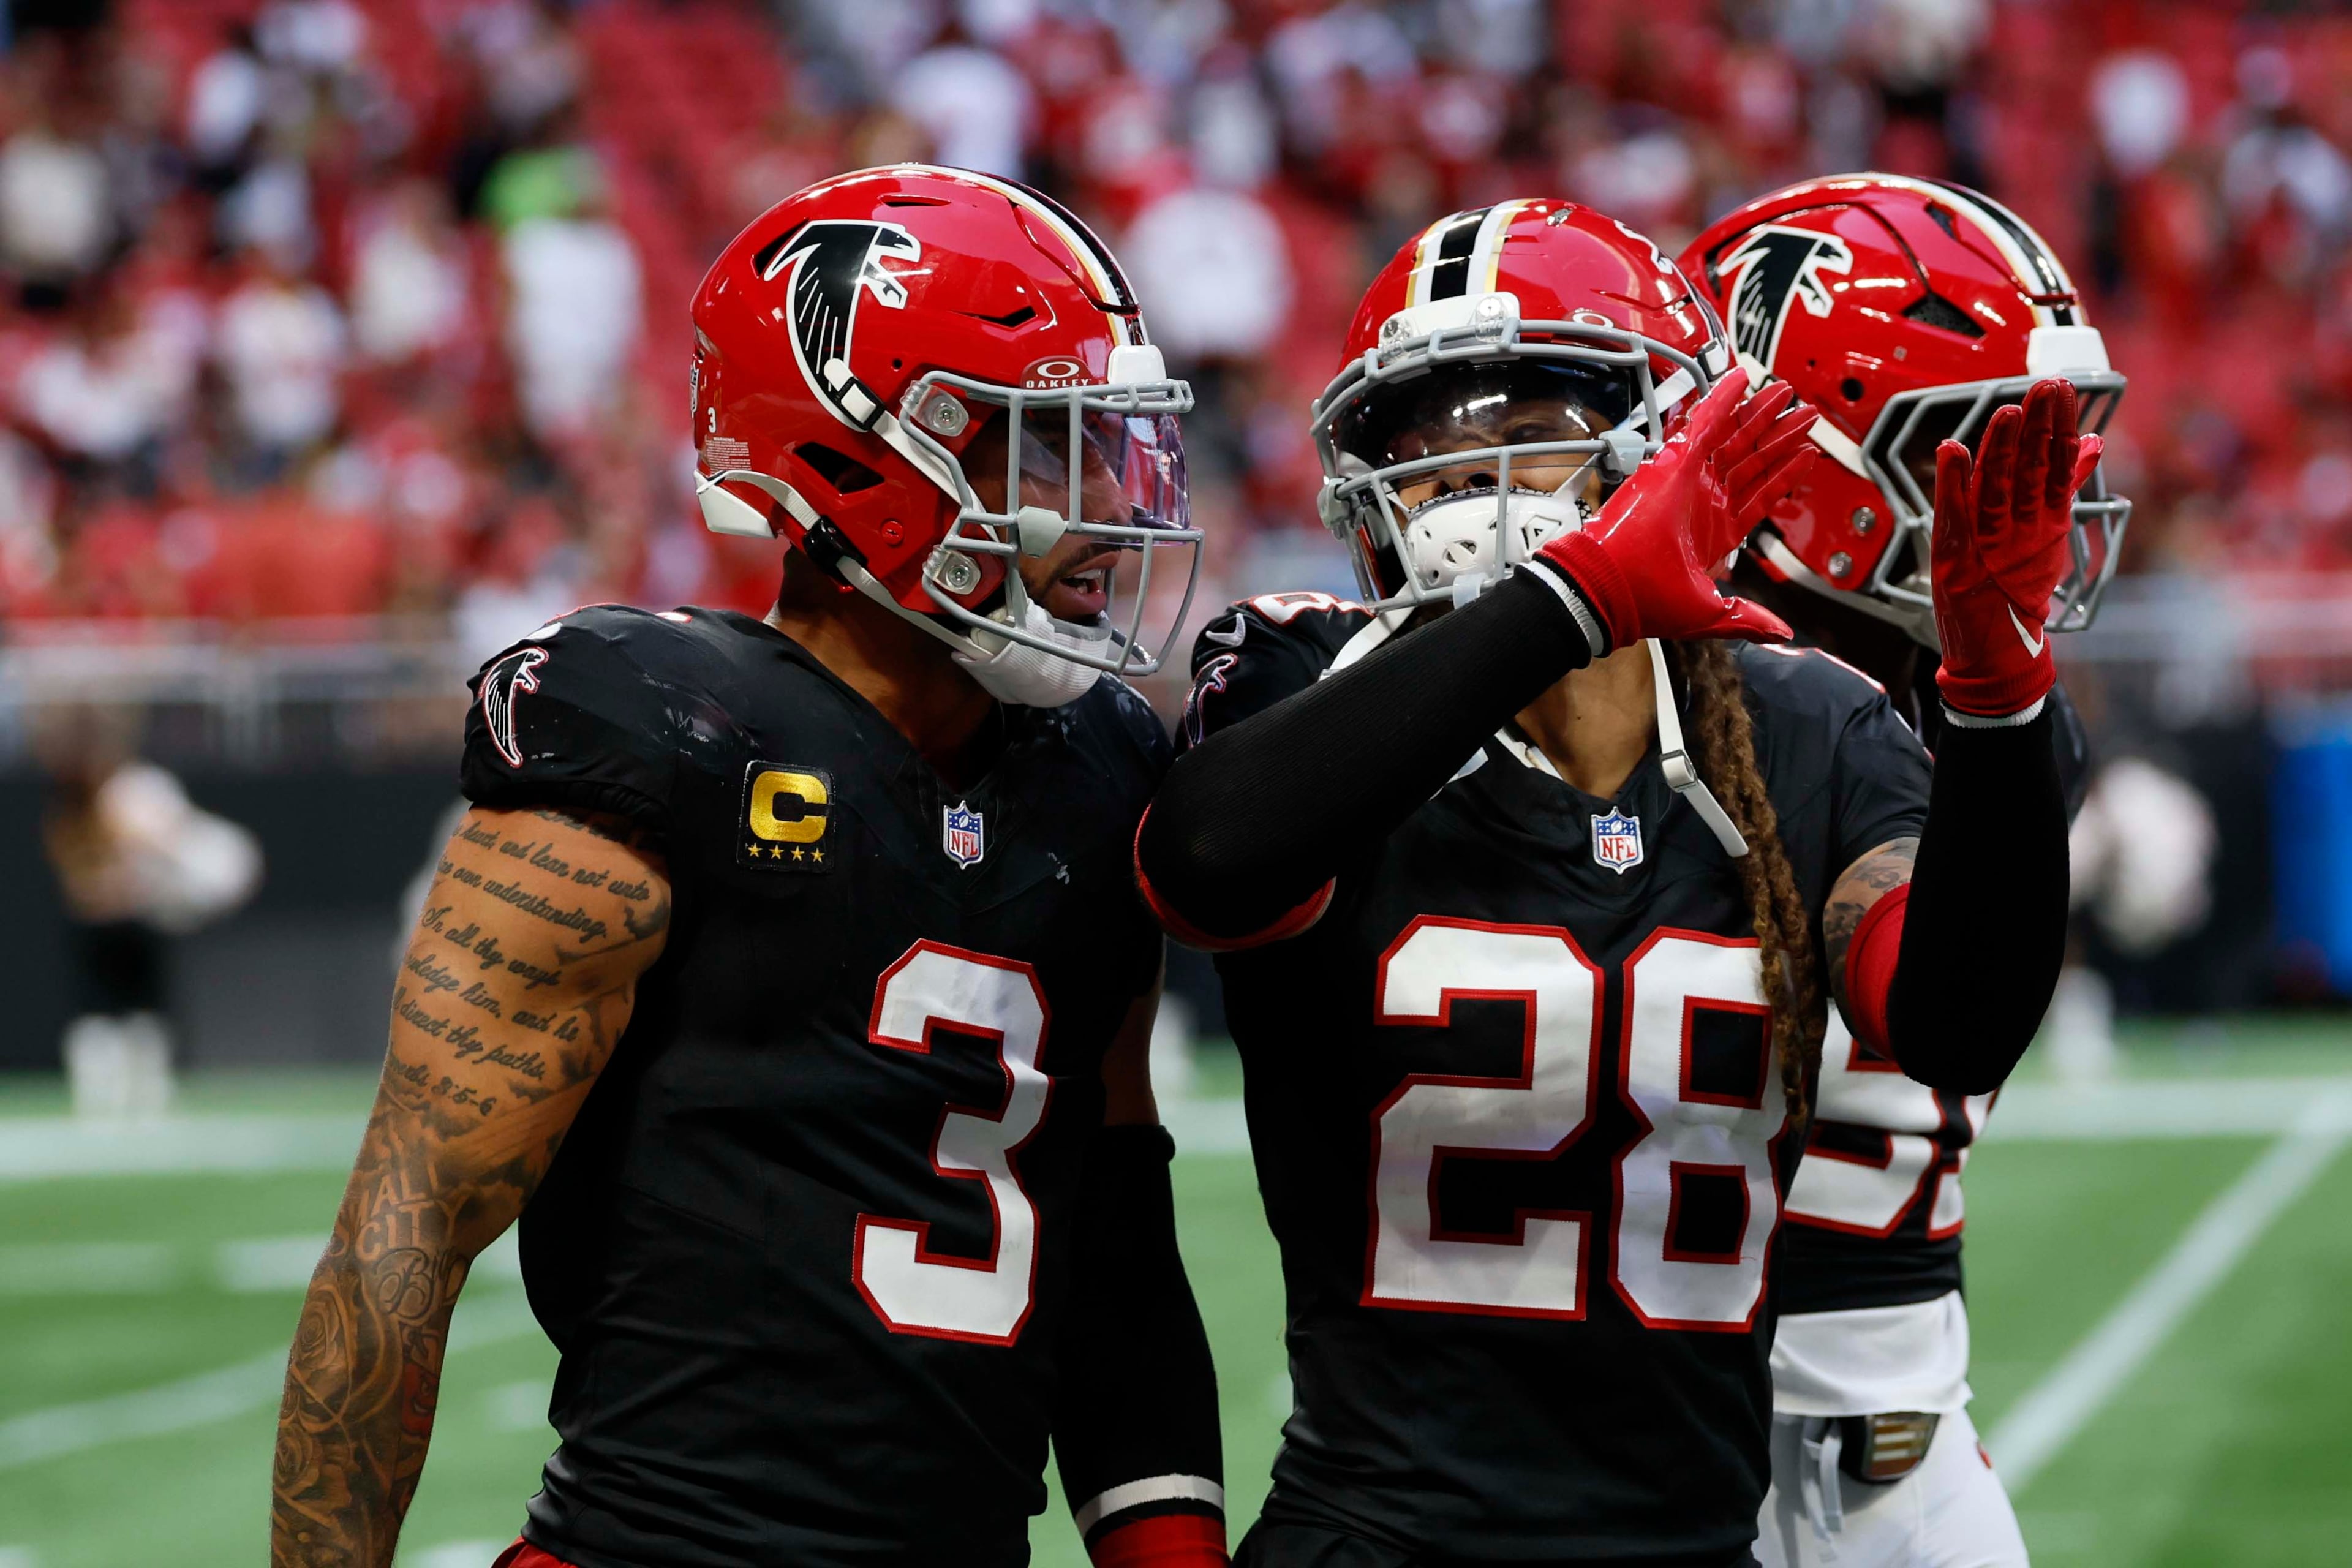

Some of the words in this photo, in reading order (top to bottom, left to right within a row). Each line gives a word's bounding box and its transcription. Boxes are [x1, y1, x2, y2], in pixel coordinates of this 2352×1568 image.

[1025, 379, 1089, 388] OAKLEY
[707, 407, 717, 433] 3
[749, 770, 828, 843] C
[530, 843, 569, 877] lean
[571, 867, 610, 888] not
[608, 880, 650, 901] unto
[951, 830, 978, 857] NFL
[1600, 837, 1636, 861] NFL
[444, 923, 480, 947] all
[473, 937, 505, 970] thy
[508, 960, 562, 990] ways
[400, 999, 450, 1036] direct
[446, 1026, 483, 1058] thy
[511, 1011, 557, 1031] and
[554, 1016, 579, 1042] he
[852, 938, 1055, 1347] 3
[1360, 914, 1802, 1333] 28
[356, 1194, 470, 1261] CITY
